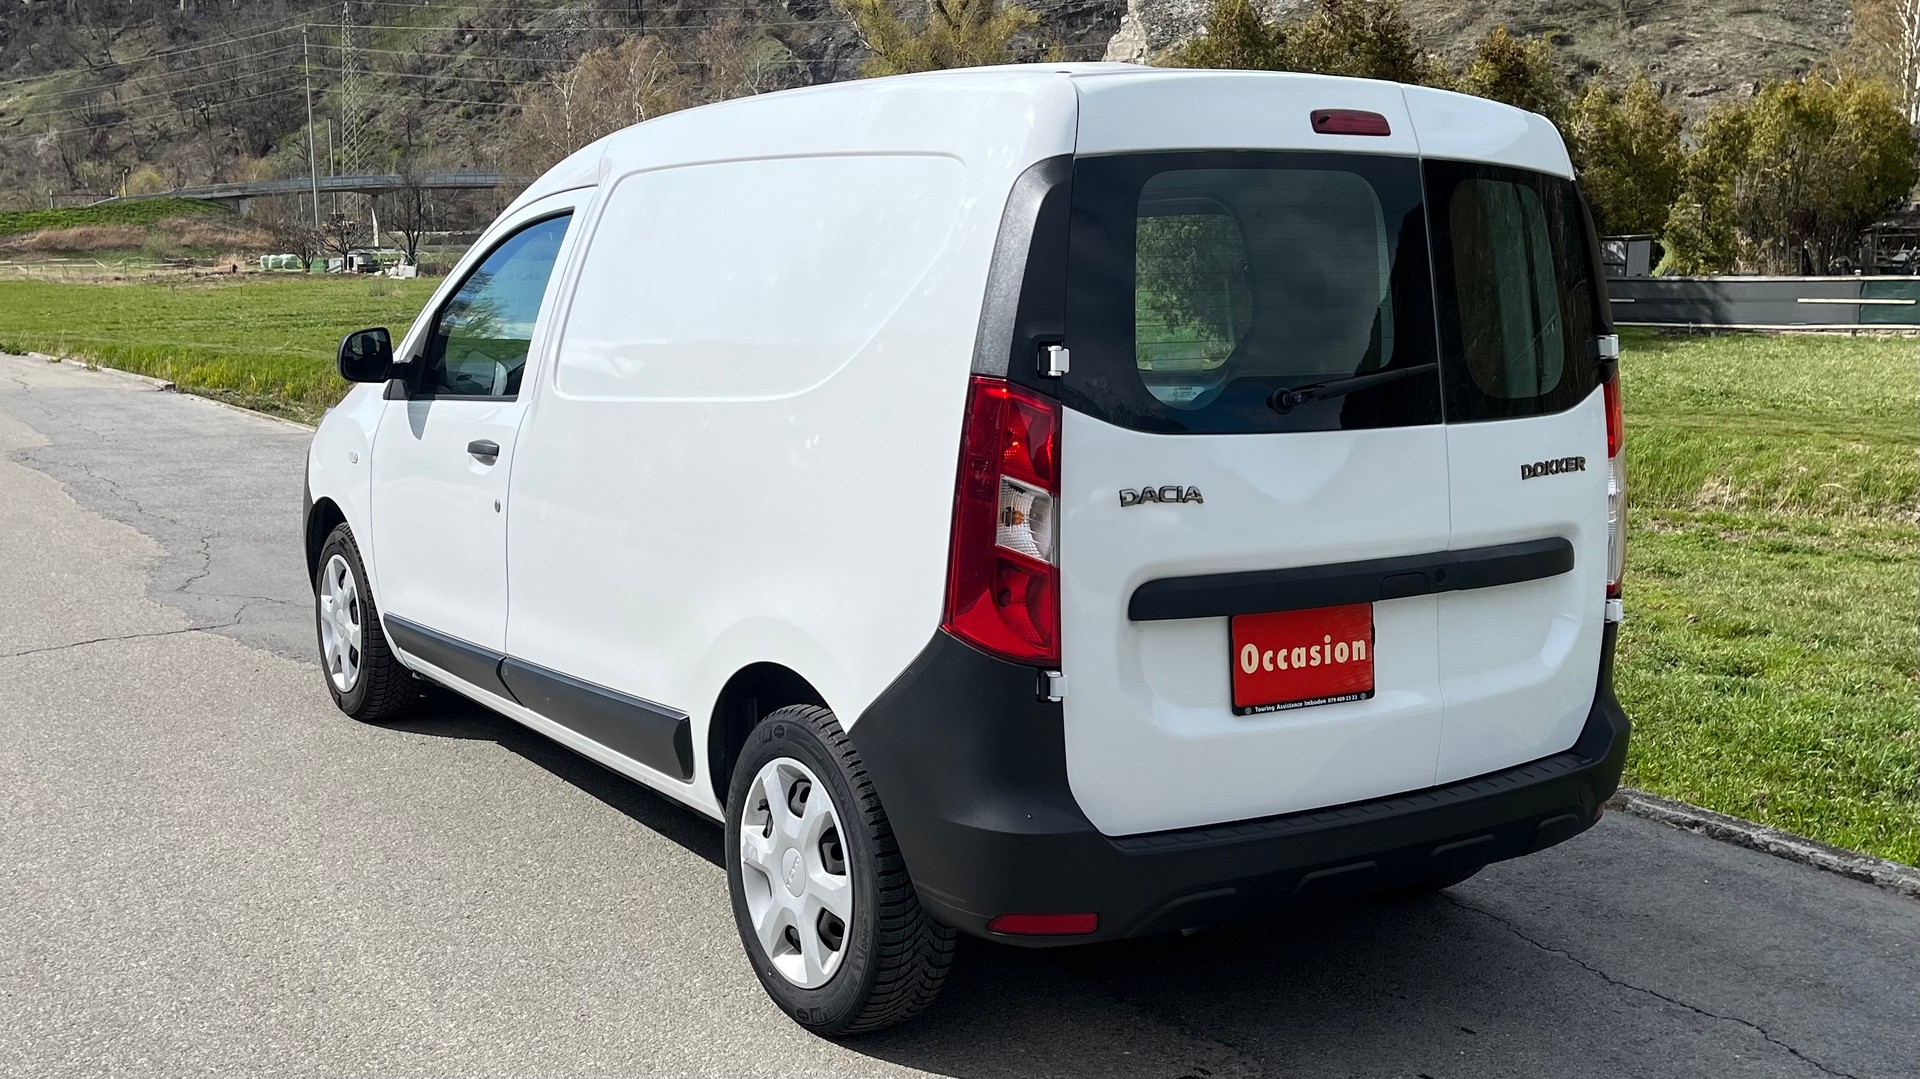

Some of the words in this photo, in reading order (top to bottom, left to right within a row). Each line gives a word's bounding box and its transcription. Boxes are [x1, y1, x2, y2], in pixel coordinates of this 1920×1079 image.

[1520, 456, 1586, 480] DOKKER
[1119, 486, 1204, 507] DACIA
[1240, 634, 1366, 674] Occasion
[1255, 704, 1275, 713] Touring
[1276, 702, 1303, 710] Assistance
[1303, 699, 1326, 707] Imboden
